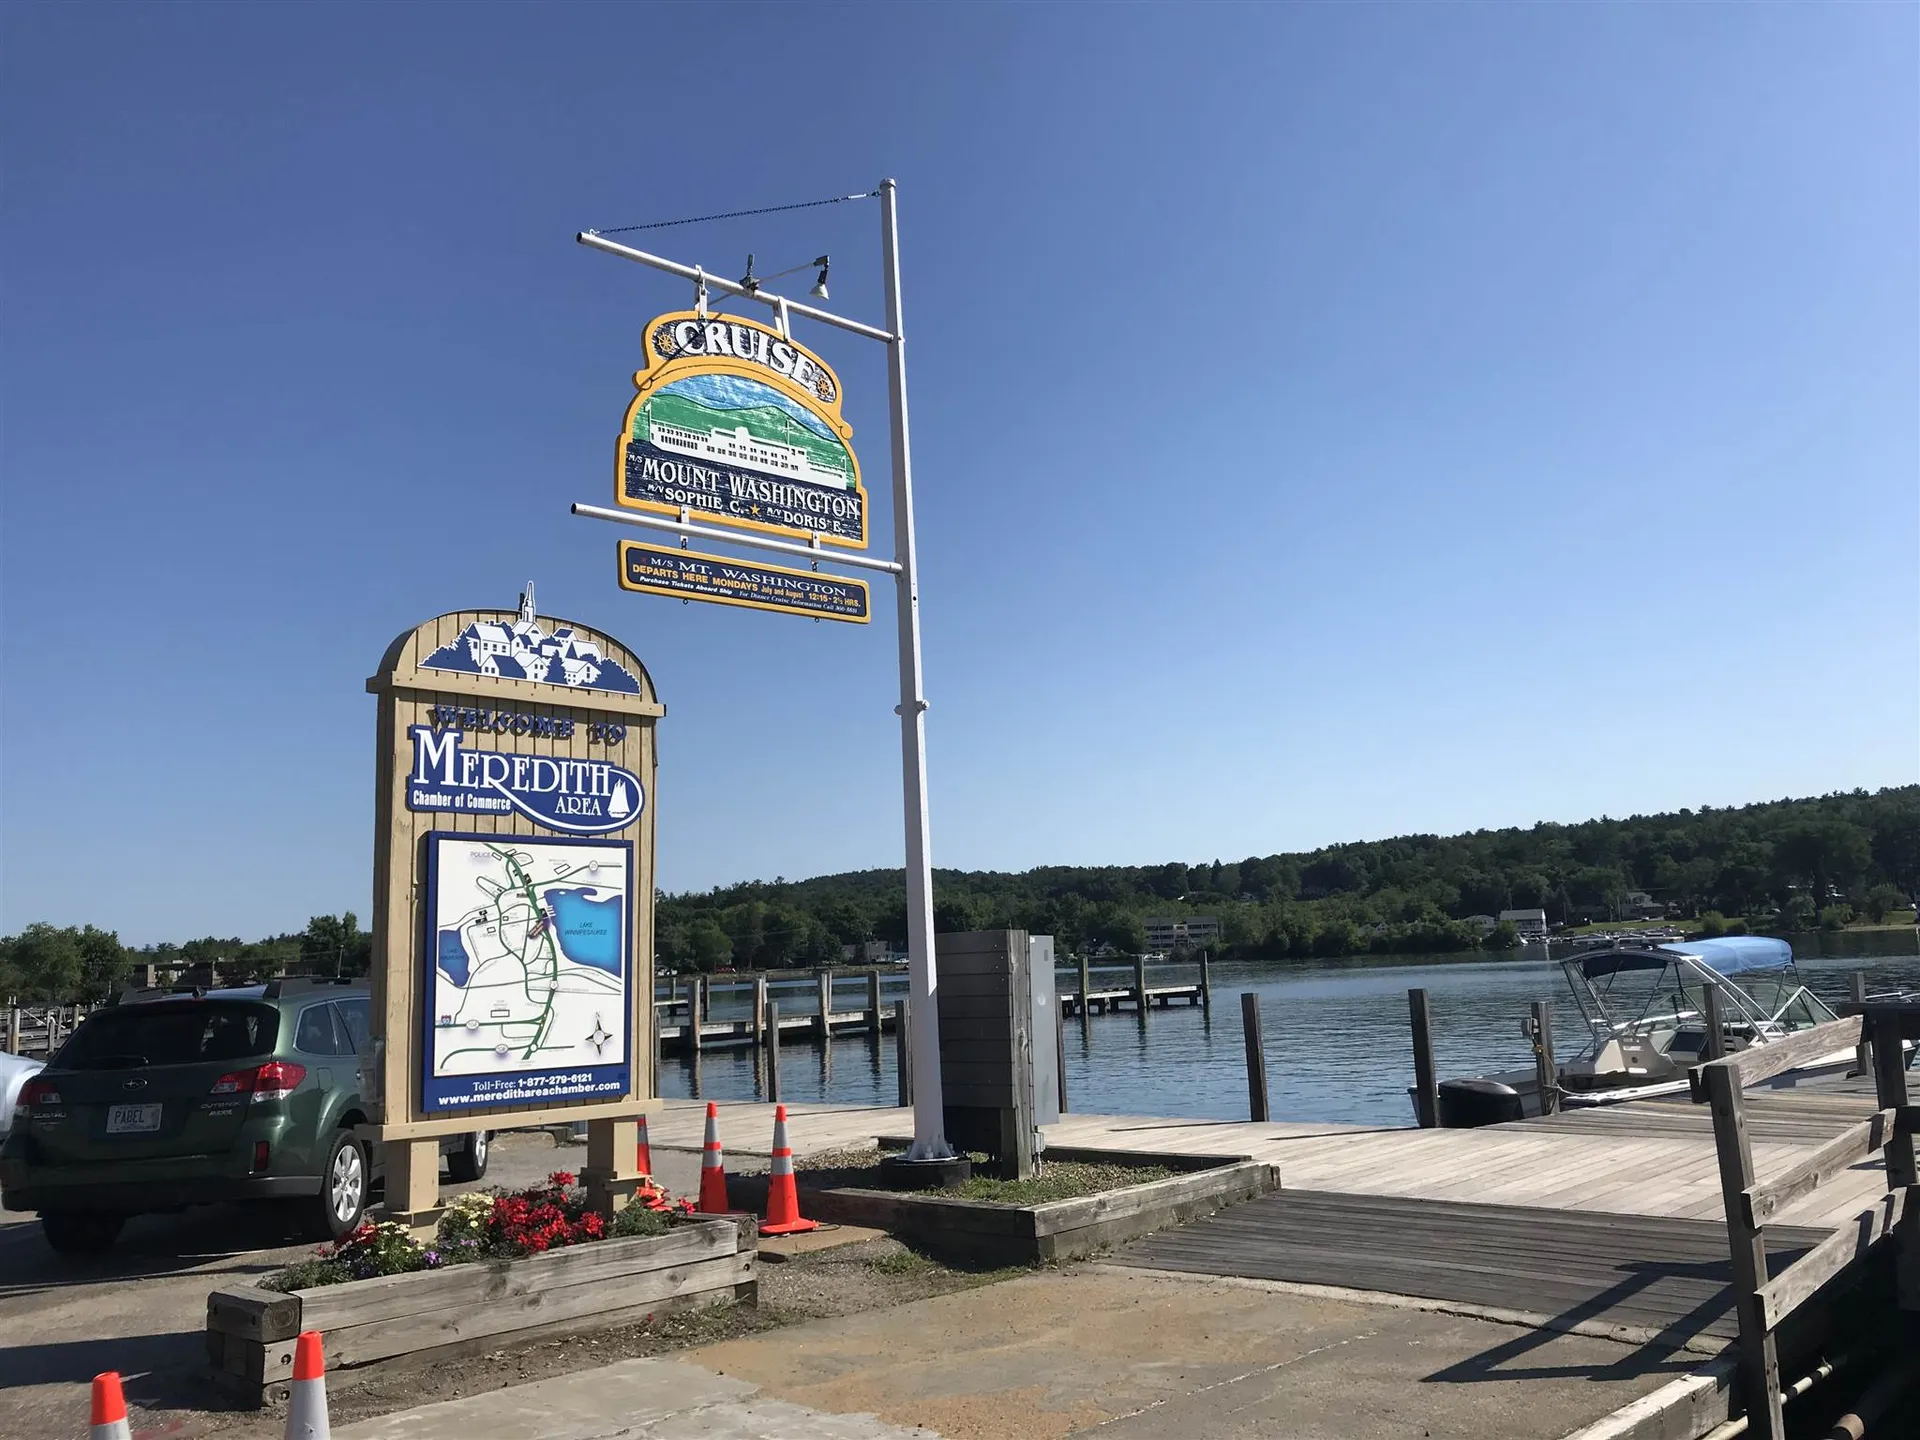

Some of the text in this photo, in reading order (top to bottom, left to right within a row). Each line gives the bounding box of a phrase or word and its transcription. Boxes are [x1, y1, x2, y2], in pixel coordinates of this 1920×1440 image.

[674, 321, 817, 390] CRUISE
[642, 458, 720, 492] MOUNT
[729, 474, 859, 520] WASHINGTON
[664, 487, 723, 510] SOPHIE
[730, 500, 745, 514] C.
[783, 509, 827, 530] DORIS
[833, 520, 845, 534] E.
[632, 564, 679, 579] DEPARTS
[682, 573, 708, 584] HERE
[712, 577, 758, 592] MONDAYS
[761, 585, 773, 595] July
[785, 589, 805, 599] August
[809, 592, 828, 602] 12:15
[639, 576, 670, 586] Purchase
[671, 580, 694, 589] Tickets
[695, 584, 717, 593] Aboard
[719, 587, 733, 595] Ship
[651, 557, 846, 597] M/S MT. WASHINGTON
[433, 704, 627, 744] WELCOME TO
[413, 728, 612, 798] MEREDITH
[413, 789, 511, 811] Chamber of Commerce
[554, 796, 603, 816] AREA
[438, 1082, 621, 1105] www.meredithareachamber.com
[473, 1073, 592, 1092] Toll-Free: 1-877-279-6121
